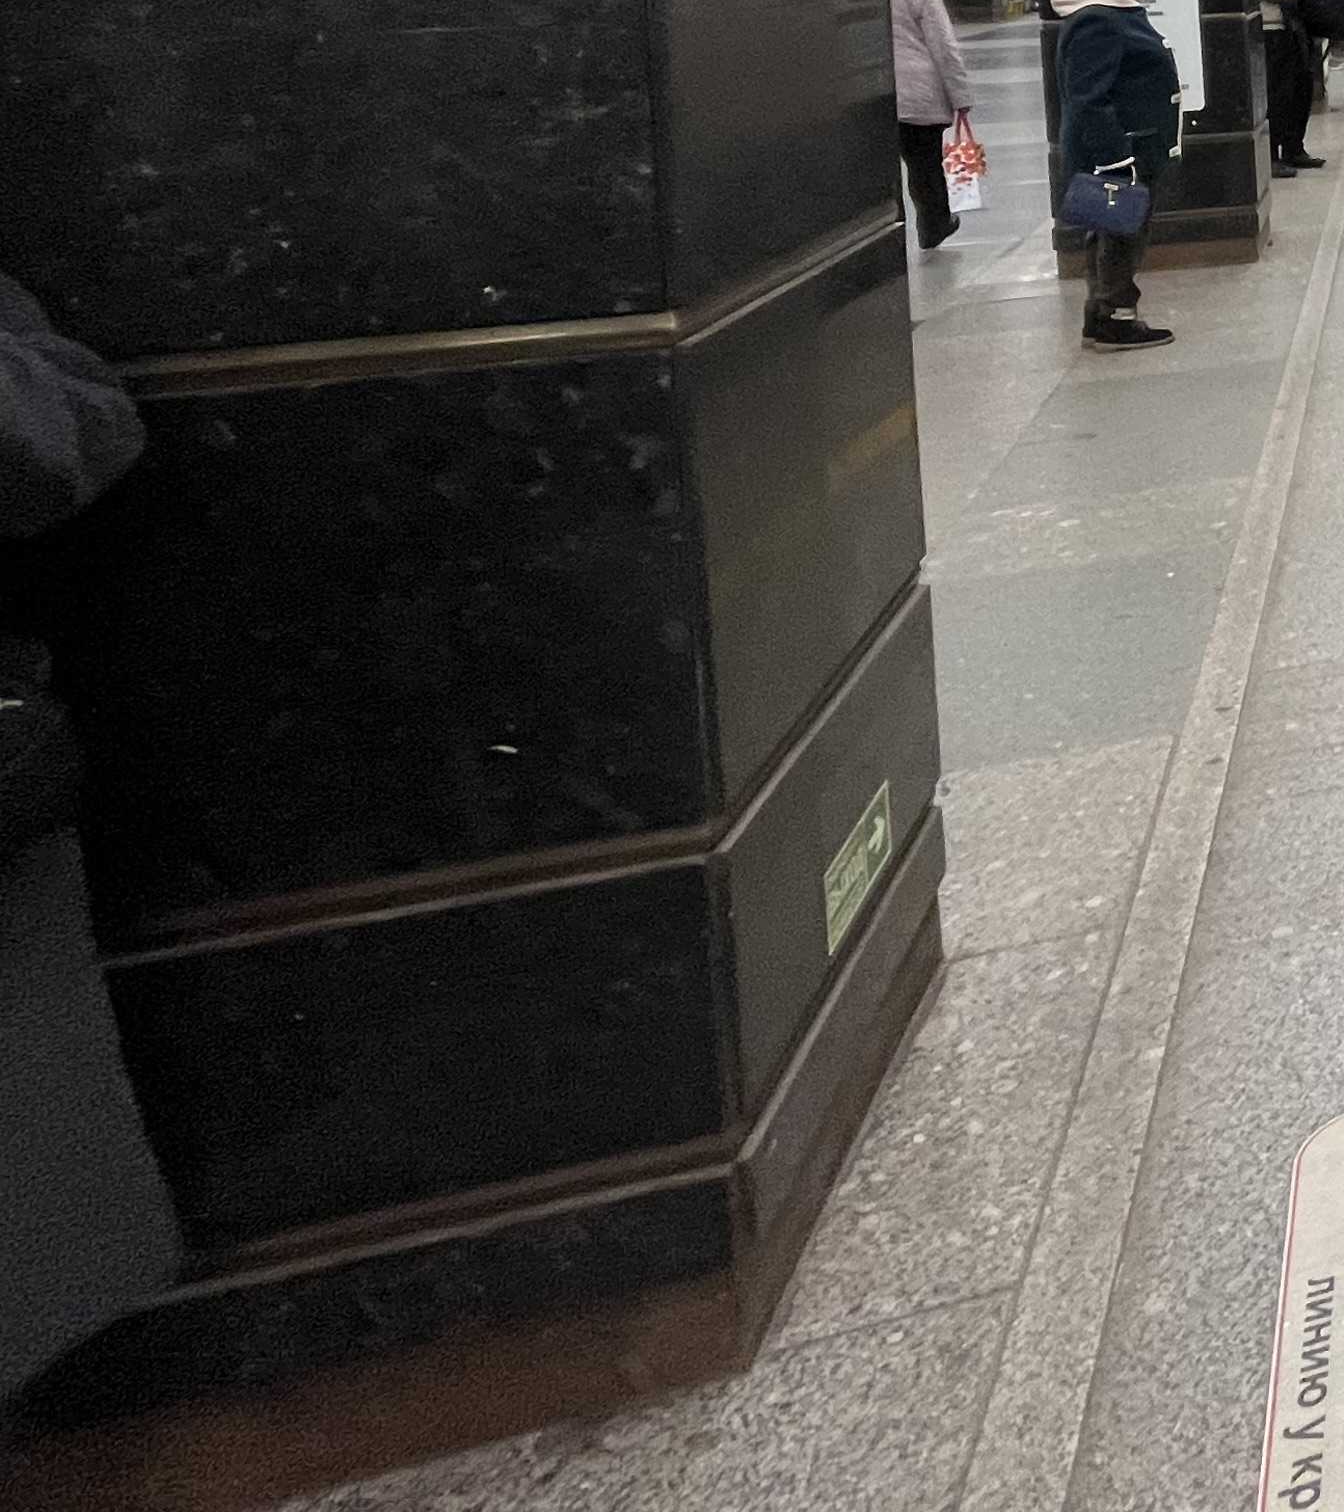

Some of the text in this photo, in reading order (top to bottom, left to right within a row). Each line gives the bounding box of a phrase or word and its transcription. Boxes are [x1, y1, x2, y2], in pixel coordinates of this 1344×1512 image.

[1277, 1275, 1335, 1512] линию у кр
